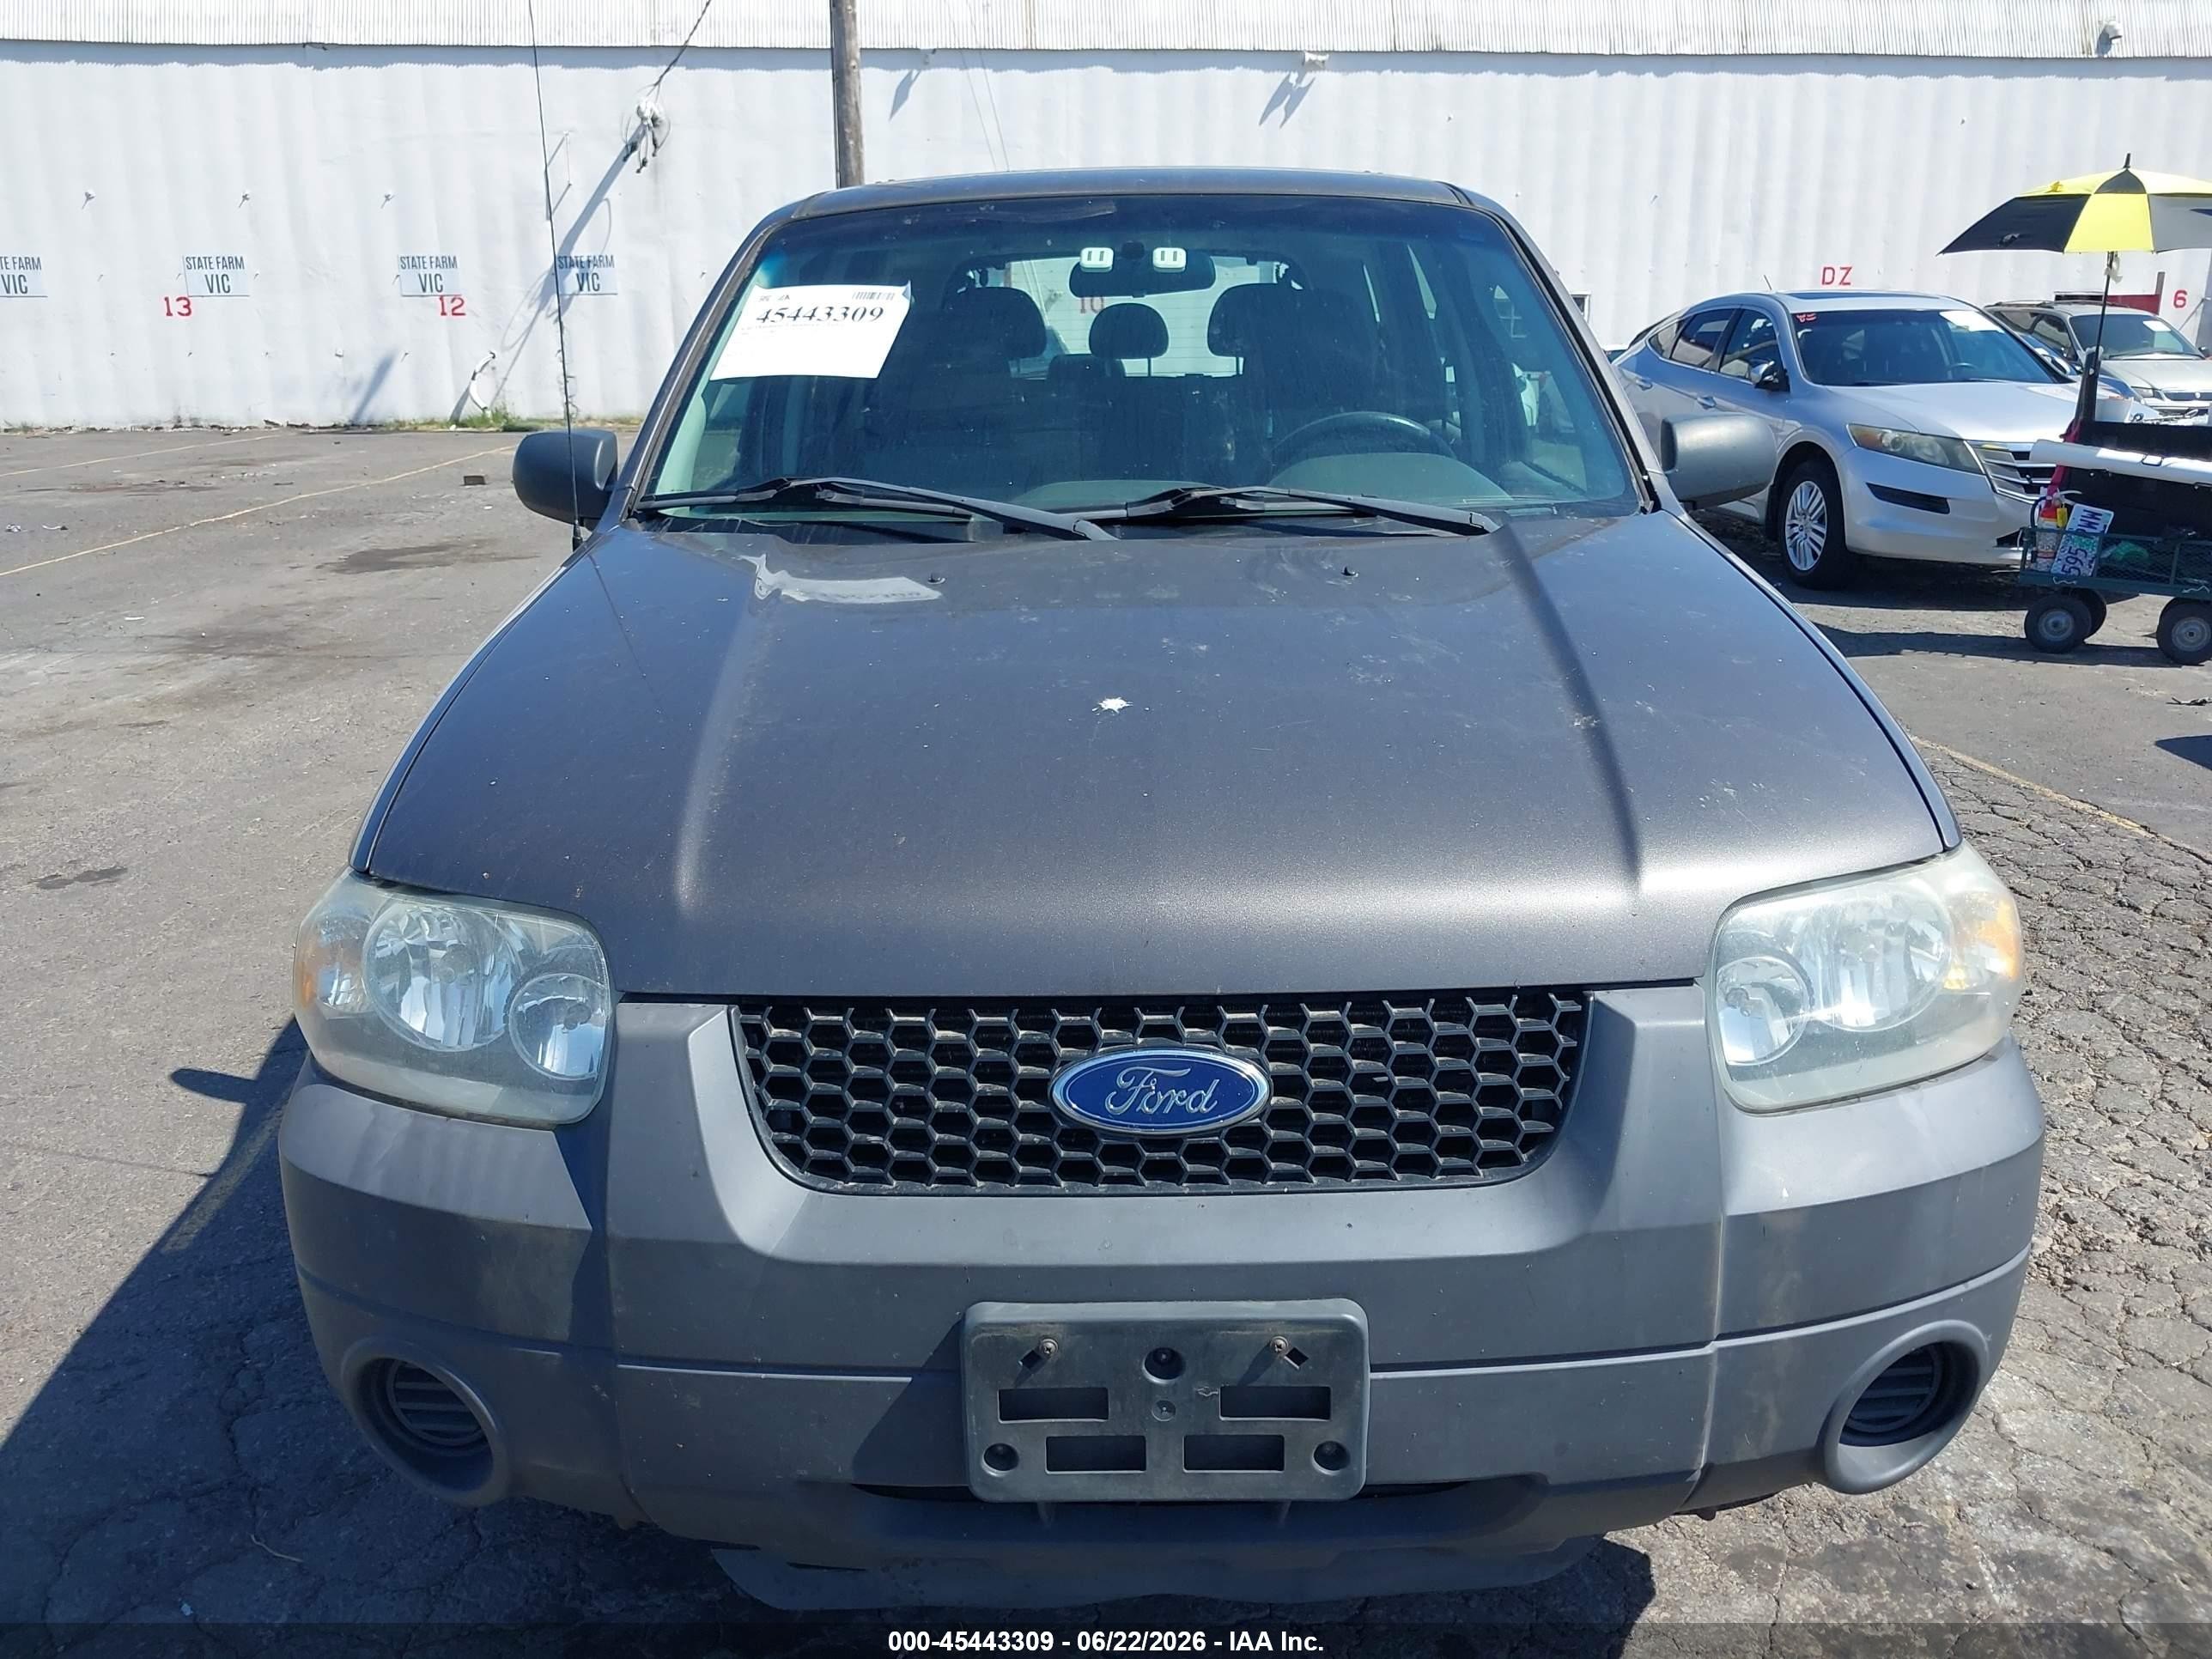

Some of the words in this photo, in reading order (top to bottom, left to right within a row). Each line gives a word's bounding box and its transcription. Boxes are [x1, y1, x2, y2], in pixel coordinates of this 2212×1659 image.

[12, 256, 42, 270] FARM
[185, 256, 215, 270] STATE
[216, 256, 245, 270] FARM
[400, 256, 428, 270] STATE
[429, 256, 458, 270] FARM
[558, 255, 586, 269] STATE
[587, 255, 615, 269] FARM
[1, 274, 28, 295] VIC
[204, 274, 231, 294] VIC
[418, 273, 444, 294] VIC
[576, 272, 600, 292] VIC
[1821, 266, 1852, 286] DZ
[163, 296, 192, 317] 13
[439, 296, 466, 316] 12
[2173, 289, 2188, 308] 6
[755, 306, 884, 324] 45443309
[2061, 545, 2087, 576] 595
[1104, 1066, 1220, 1115] Ford
